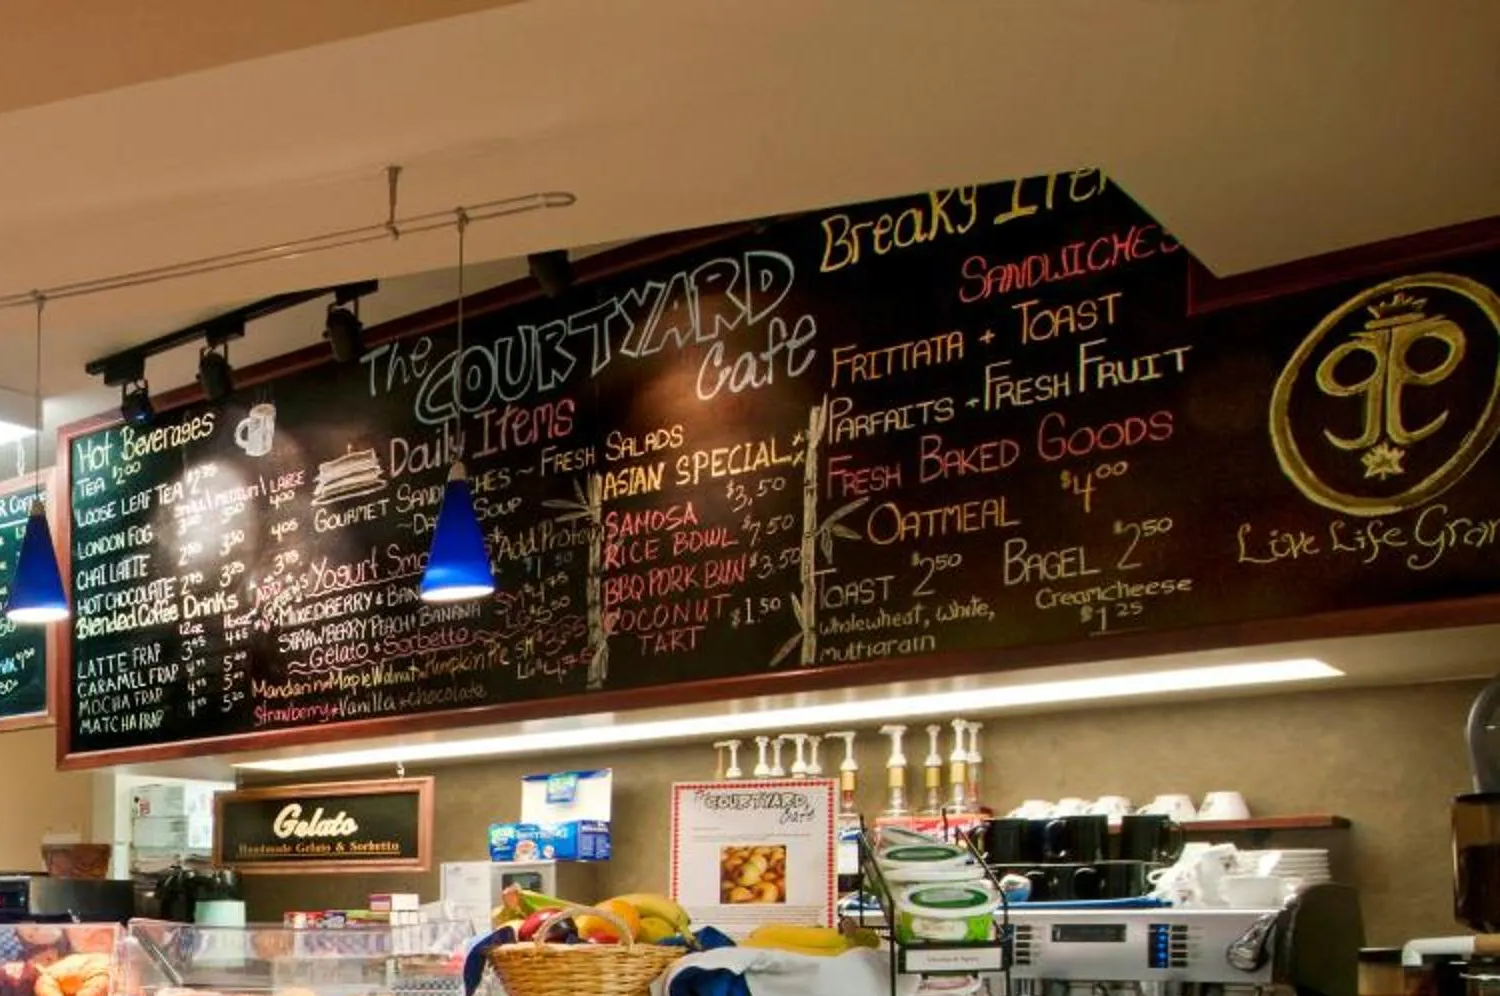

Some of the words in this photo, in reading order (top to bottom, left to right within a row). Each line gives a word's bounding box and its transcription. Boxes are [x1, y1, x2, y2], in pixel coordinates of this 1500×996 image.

[819, 183, 977, 273] Breaky
[414, 250, 795, 425] COURTYARD
[696, 313, 817, 400] Cafe
[831, 330, 966, 388] FRITTATA
[1011, 291, 1123, 345] TOAST
[359, 335, 431, 397] The
[827, 396, 955, 445] PARFAITS
[984, 359, 1071, 412] FRESH
[1079, 337, 1193, 393] FRUIT
[76, 431, 113, 474] Hot
[119, 411, 216, 461] Beverages
[389, 418, 465, 479] Daily
[471, 398, 576, 459] Items
[827, 454, 903, 500] FRESH
[919, 434, 1020, 484] BAKED
[1037, 410, 1174, 463] GOODS
[76, 476, 106, 498] TEA
[314, 499, 390, 534] GOURMET
[541, 446, 596, 477] FRESH
[605, 423, 685, 462] SALADS
[603, 461, 666, 502] ASIAN
[675, 437, 793, 487] SPECIAL
[76, 501, 117, 528] LOOSE
[121, 489, 154, 516] LEAF
[156, 481, 184, 506] TEA
[472, 496, 524, 522] SOUP
[604, 501, 699, 541] SAMOSA
[866, 495, 1021, 546] OATMEAL
[76, 532, 125, 560] LONDON
[127, 524, 154, 548] FOG
[603, 538, 661, 571] RICE
[673, 527, 741, 555] BOWL
[1003, 537, 1102, 587] BAGEL
[1236, 521, 1320, 563] Live
[1329, 518, 1408, 564] Life
[76, 565, 106, 590] CHAI
[109, 553, 151, 583] LATTE
[311, 546, 379, 594] Yogurt
[603, 574, 645, 608] BBQ
[649, 563, 700, 598] PORK
[703, 553, 748, 590] BUN
[814, 567, 895, 611] TOAST
[75, 604, 138, 640] Blended
[137, 600, 179, 627] Coffee
[183, 590, 239, 619] Drinks
[76, 593, 102, 616] HOT
[105, 576, 177, 608] CHOCOLATE
[603, 592, 734, 636] COCONUT
[277, 617, 367, 653] STRAWBERRY
[418, 603, 482, 628] BANANA
[308, 641, 370, 670] Gelato
[382, 626, 470, 655] Sorbetto
[639, 625, 707, 657] TART
[77, 651, 128, 680] LATTE
[132, 642, 162, 665] FRAP
[77, 672, 148, 699] CARAMEL
[149, 663, 180, 685] FRAP
[78, 693, 131, 717] MOCHA
[135, 687, 164, 708] FRAP
[138, 708, 165, 732] FRAP
[273, 802, 359, 838] Gelato
[334, 842, 345, 852] &
[349, 840, 400, 852] Sorbetto
